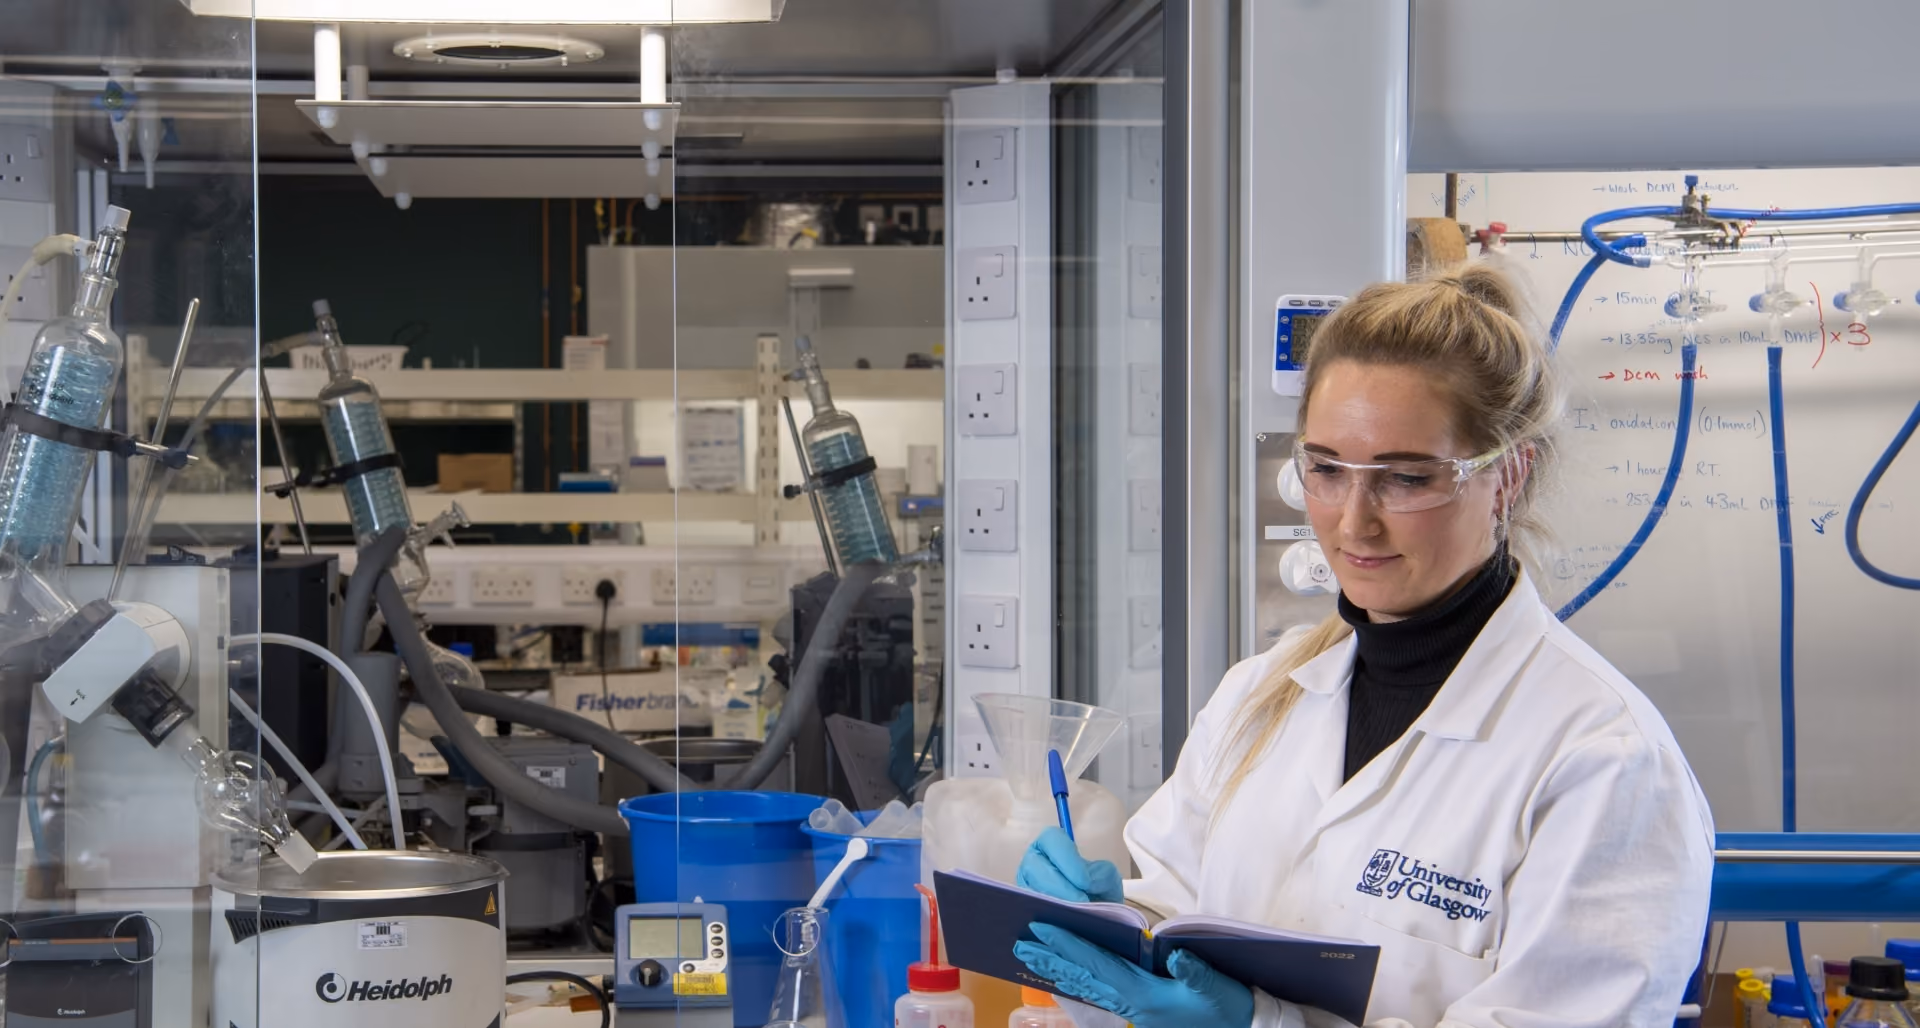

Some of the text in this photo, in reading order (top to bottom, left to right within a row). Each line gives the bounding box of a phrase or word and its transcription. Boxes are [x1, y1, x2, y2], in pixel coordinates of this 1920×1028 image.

[1615, 291, 1657, 305] 15min
[1682, 334, 1712, 346] NCS
[1784, 330, 1819, 344] DMF
[1847, 322, 1871, 346] 3
[1610, 413, 1678, 430] oxidation
[1398, 856, 1492, 907] University
[1386, 877, 1412, 900] of
[1406, 881, 1492, 923] Glasgow
[1320, 952, 1356, 960] 2022
[346, 974, 453, 1002] Heidolph
